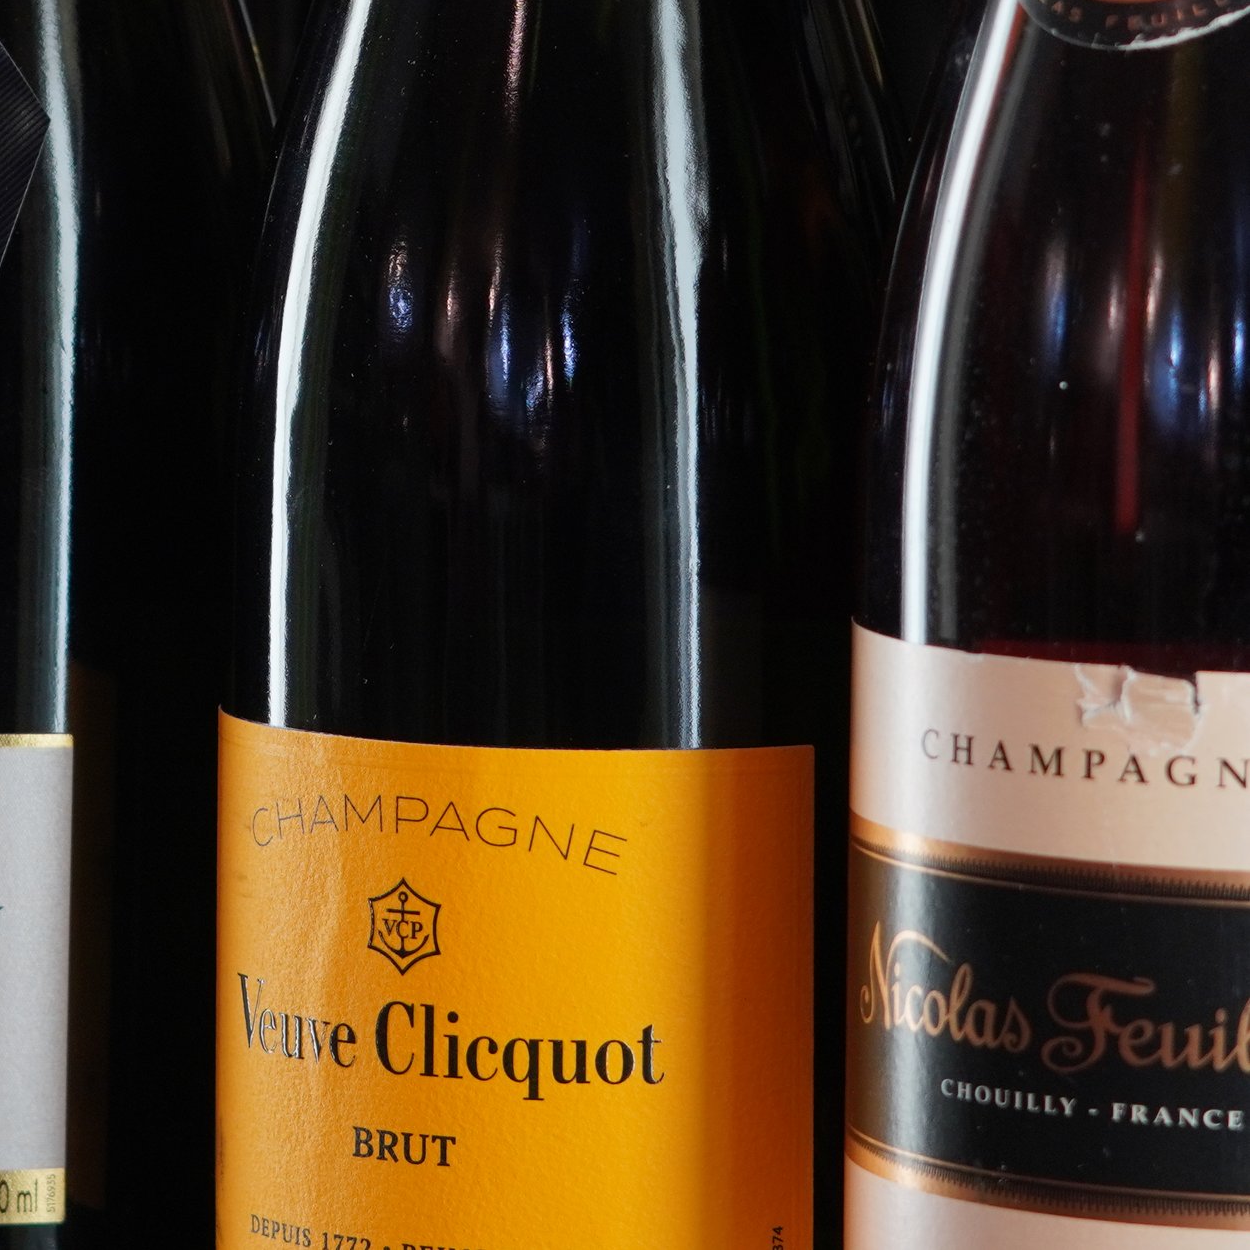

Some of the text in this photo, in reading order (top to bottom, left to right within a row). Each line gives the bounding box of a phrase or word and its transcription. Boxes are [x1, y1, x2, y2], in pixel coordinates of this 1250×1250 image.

[251, 793, 628, 876] CHAMPAGNE
[382, 917, 424, 940] VCP
[860, 920, 1032, 1053] Nicolas
[236, 972, 666, 1101] Veuve Clicquot
[940, 1078, 1079, 1117] CHOUILLY
[1111, 1102, 1245, 1132] FRANCE
[351, 1125, 457, 1168] BRUT
[16, 1177, 39, 1215] ml
[250, 1213, 313, 1248] DEPUIS
